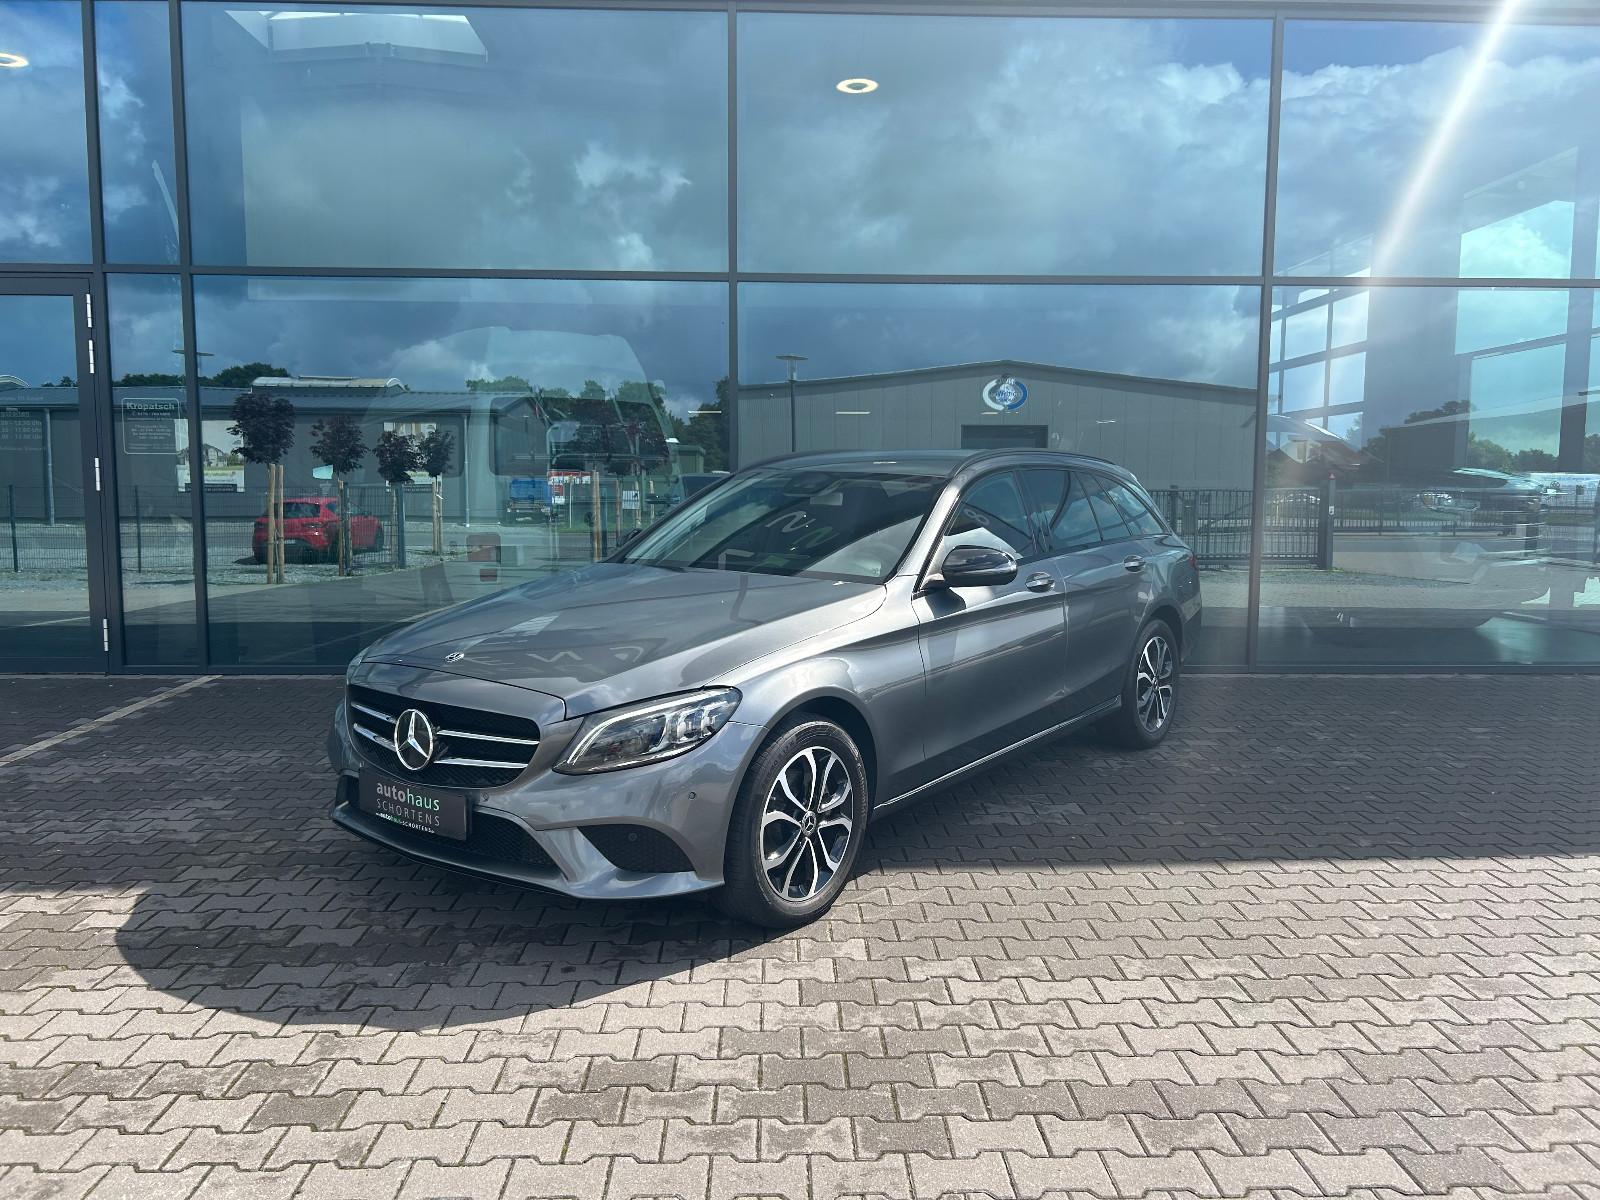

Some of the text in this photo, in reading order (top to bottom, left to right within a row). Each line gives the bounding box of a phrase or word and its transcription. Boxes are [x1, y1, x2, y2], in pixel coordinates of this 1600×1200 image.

[126, 402, 175, 411] Kropatsch
[376, 782, 440, 811] autohaus
[376, 798, 440, 827] SCHORTENS
